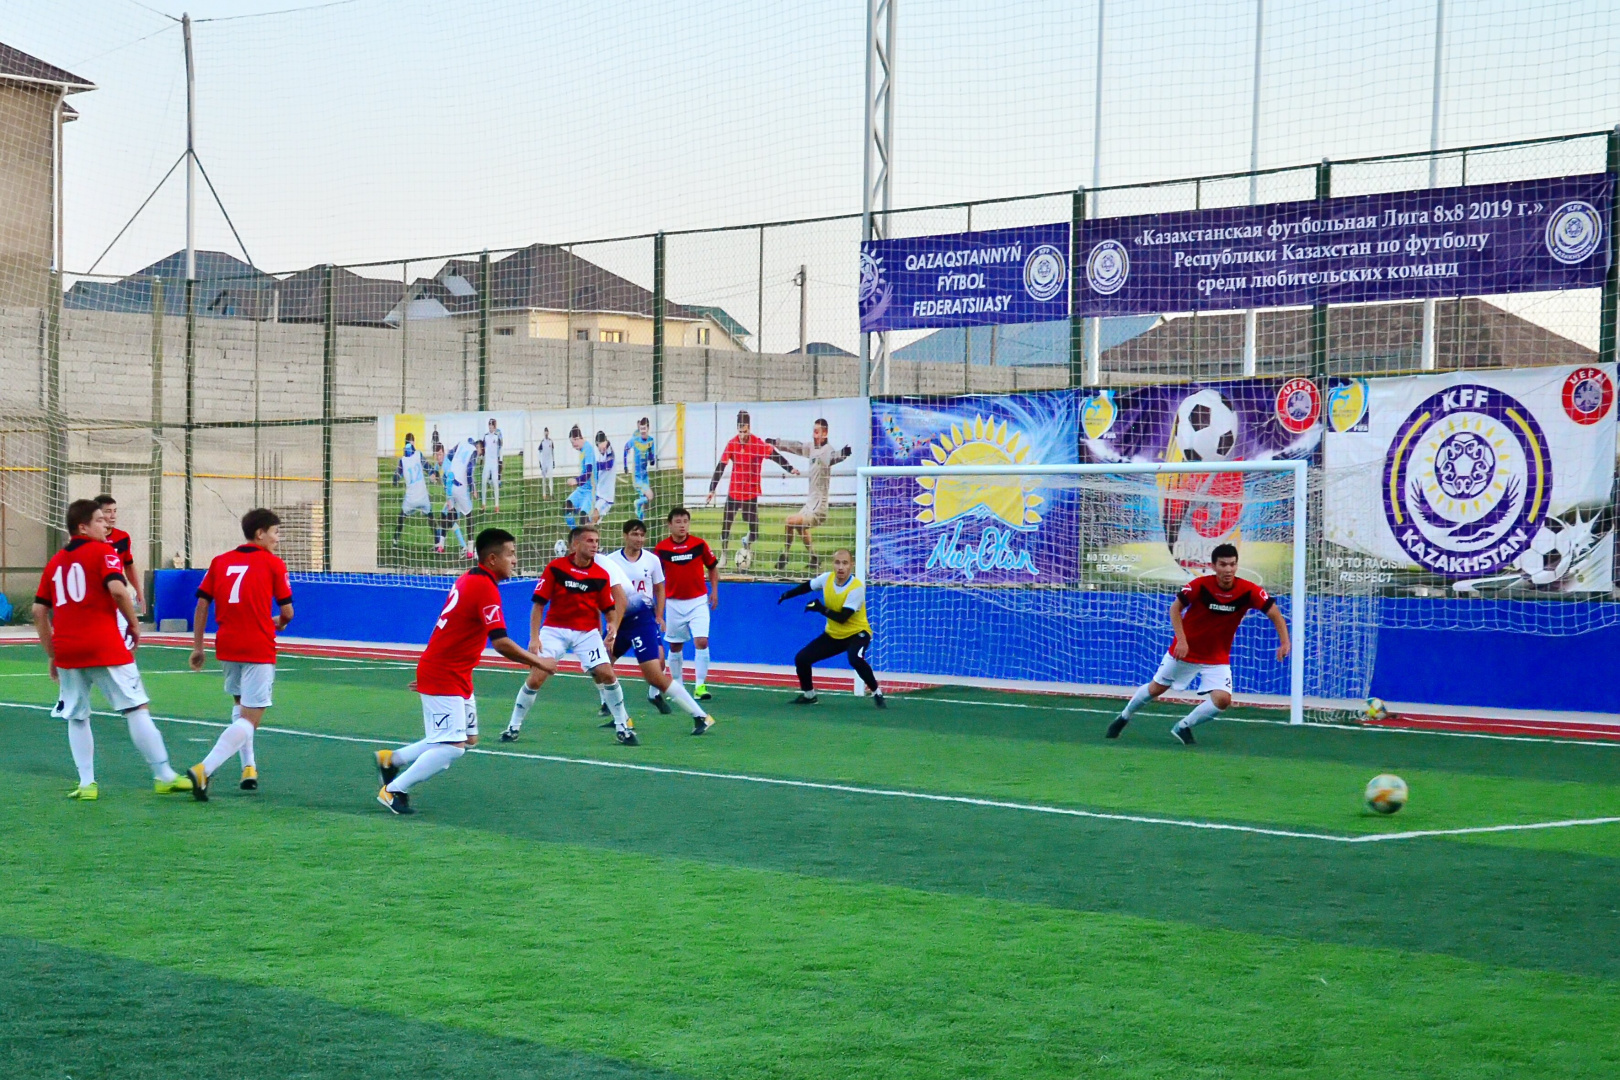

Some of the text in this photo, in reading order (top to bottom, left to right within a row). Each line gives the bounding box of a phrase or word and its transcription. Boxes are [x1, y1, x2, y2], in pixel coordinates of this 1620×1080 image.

[1134, 223, 1262, 246] «Казахстанская
[1267, 214, 1377, 241] футбольная
[1381, 209, 1429, 228] Лига
[1468, 199, 1512, 220] 2019
[1517, 200, 1544, 217] г.»
[1174, 231, 1491, 270] Республики Казахстан по футболу
[1197, 262, 1459, 295] среди любительских команд
[912, 294, 1013, 317] FEDERATSIIASY
[1283, 381, 1312, 394] UEFA
[1569, 369, 1607, 385] UEFA
[1442, 388, 1490, 412] KFF
[926, 519, 1040, 580] Nur Otan
[1099, 553, 1110, 562] TO
[1111, 553, 1142, 562] RACSM
[1402, 526, 1530, 574] KAZAKHSTAN
[1325, 557, 1344, 568] NO
[1346, 557, 1361, 568] TO
[51, 562, 87, 607] 10
[225, 565, 249, 604] 7
[1340, 571, 1394, 583] RESPECT
[588, 647, 601, 663] 21
[467, 712, 475, 729] 2
